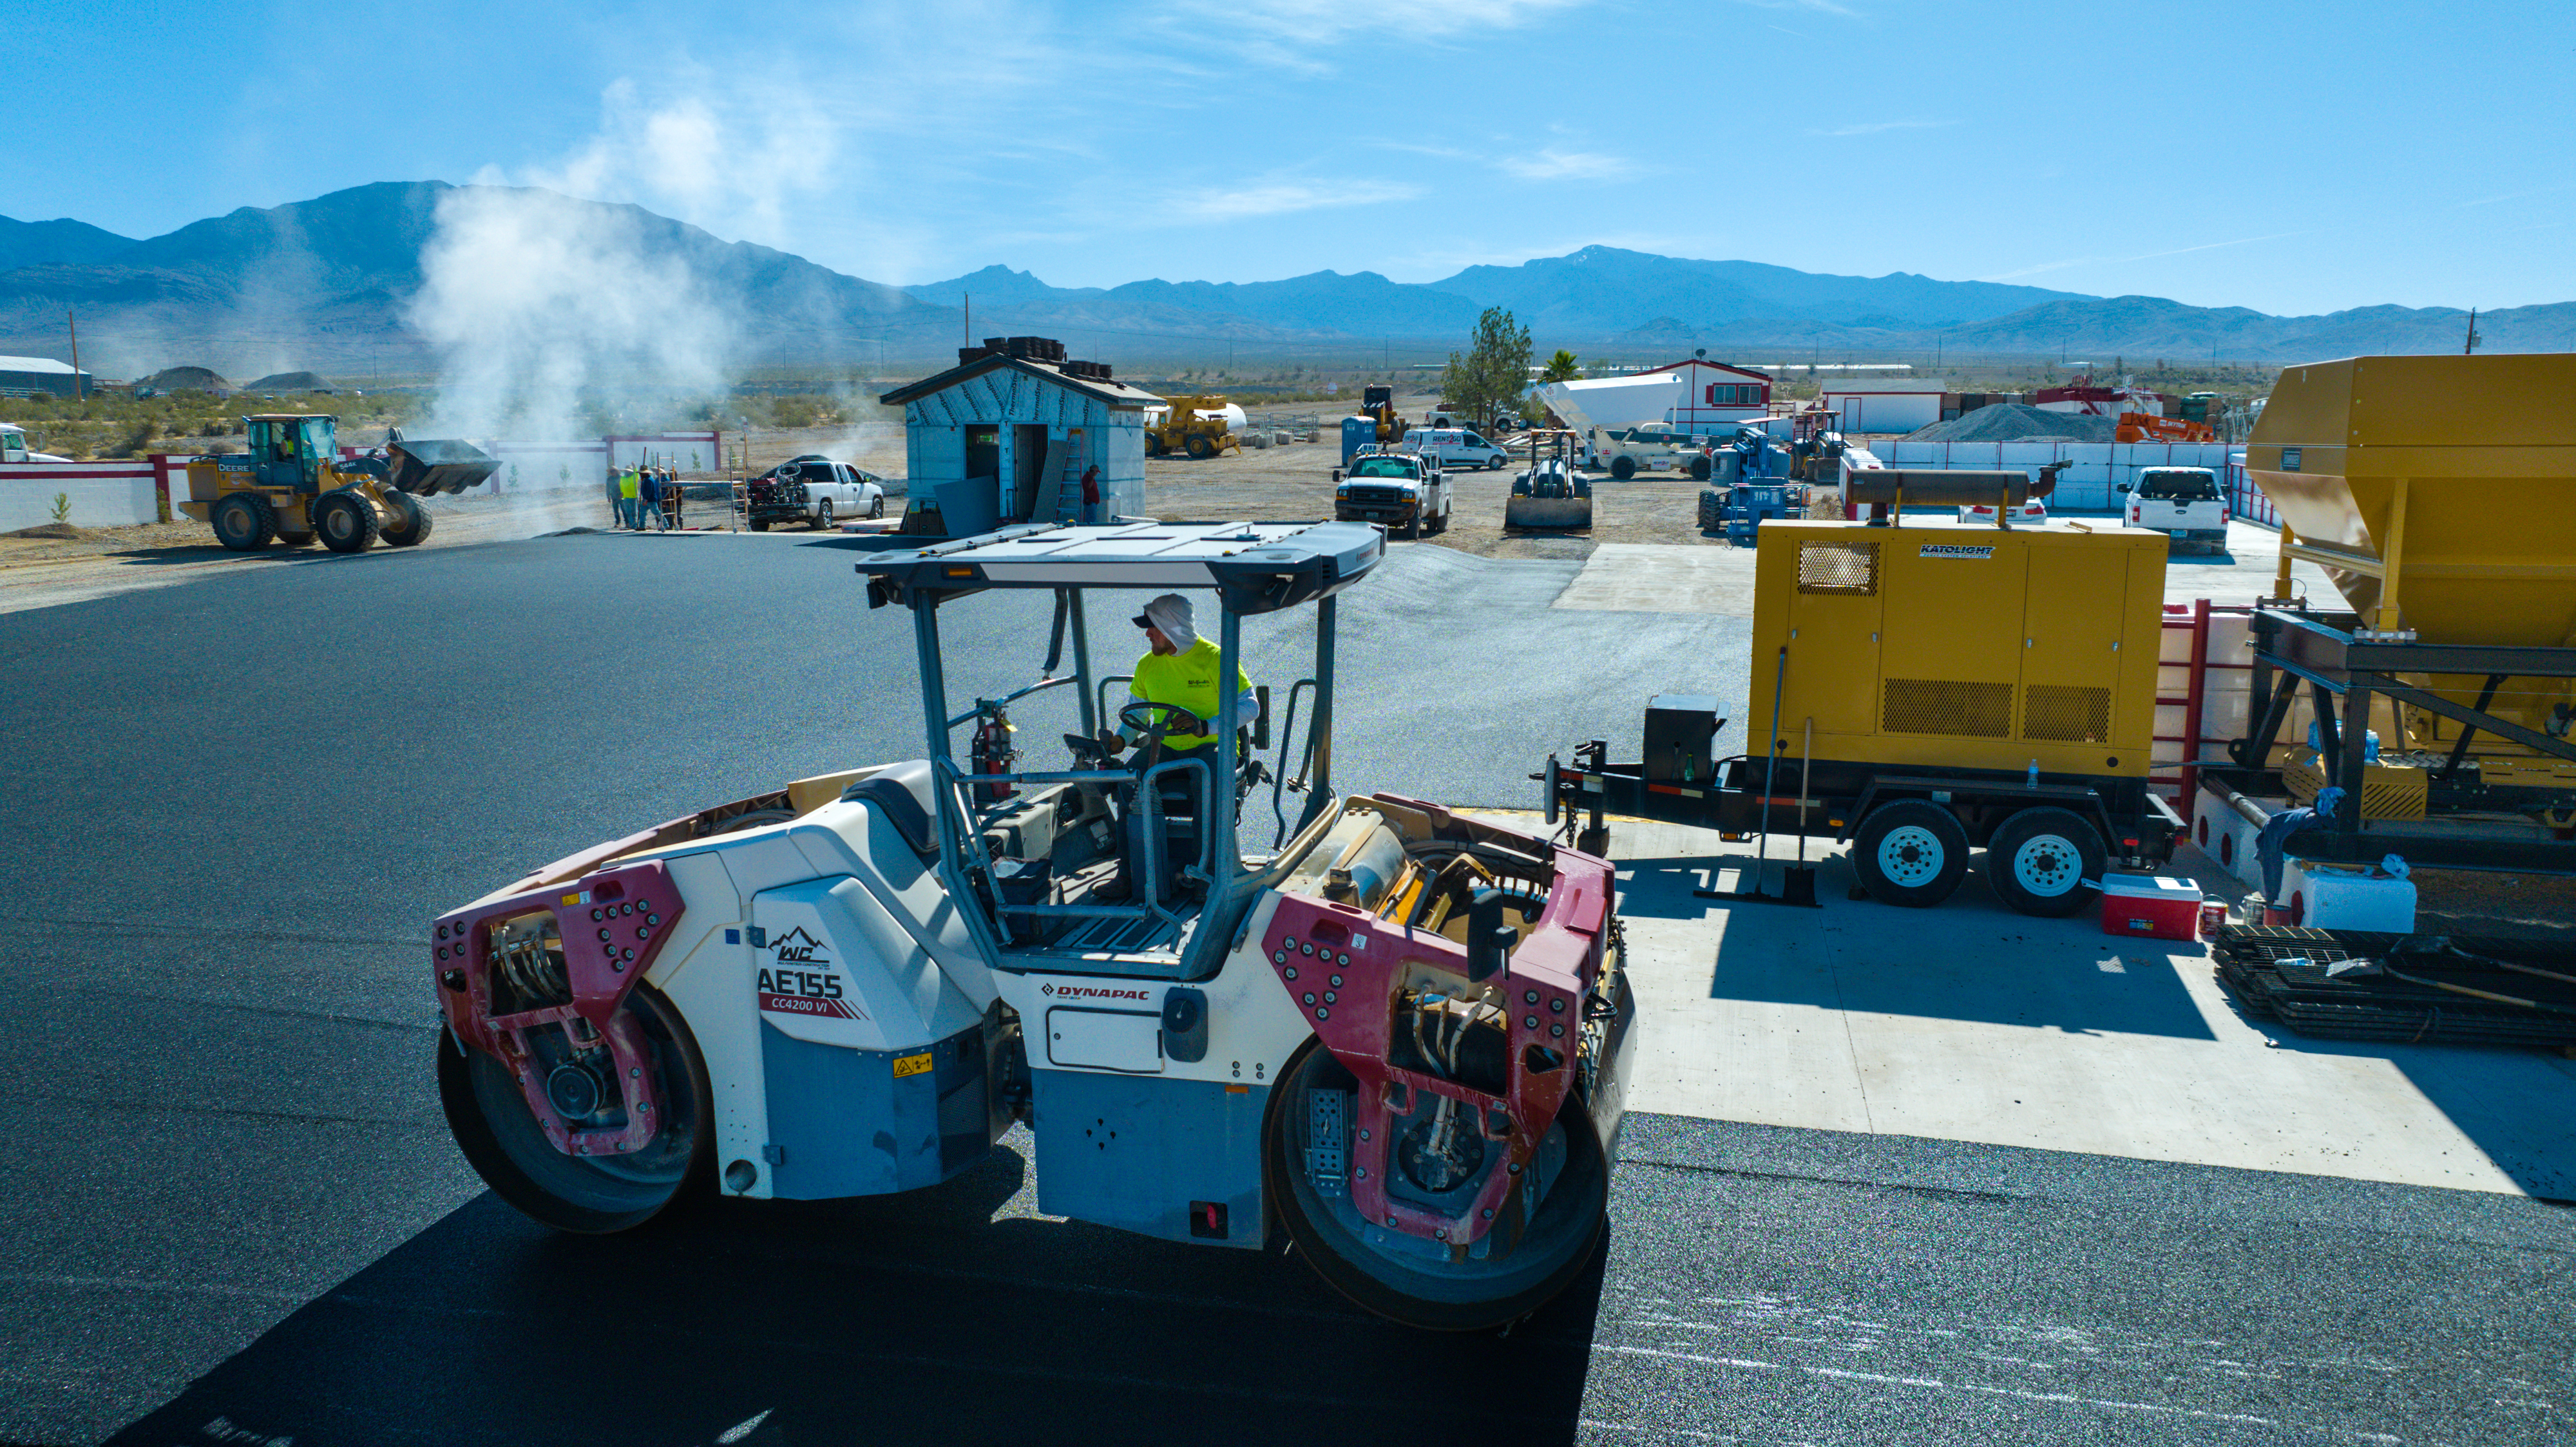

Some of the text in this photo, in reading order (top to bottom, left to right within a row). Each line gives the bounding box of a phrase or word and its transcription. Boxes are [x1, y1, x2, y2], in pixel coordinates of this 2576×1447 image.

[1433, 434, 1462, 443] RENT2GO
[1920, 545, 1995, 555] KATOLIGHT
[778, 946, 814, 961] WC
[758, 968, 843, 999] AE155
[1057, 986, 1150, 1000] DYNAPAC
[772, 998, 828, 1012] CC4200 VI
